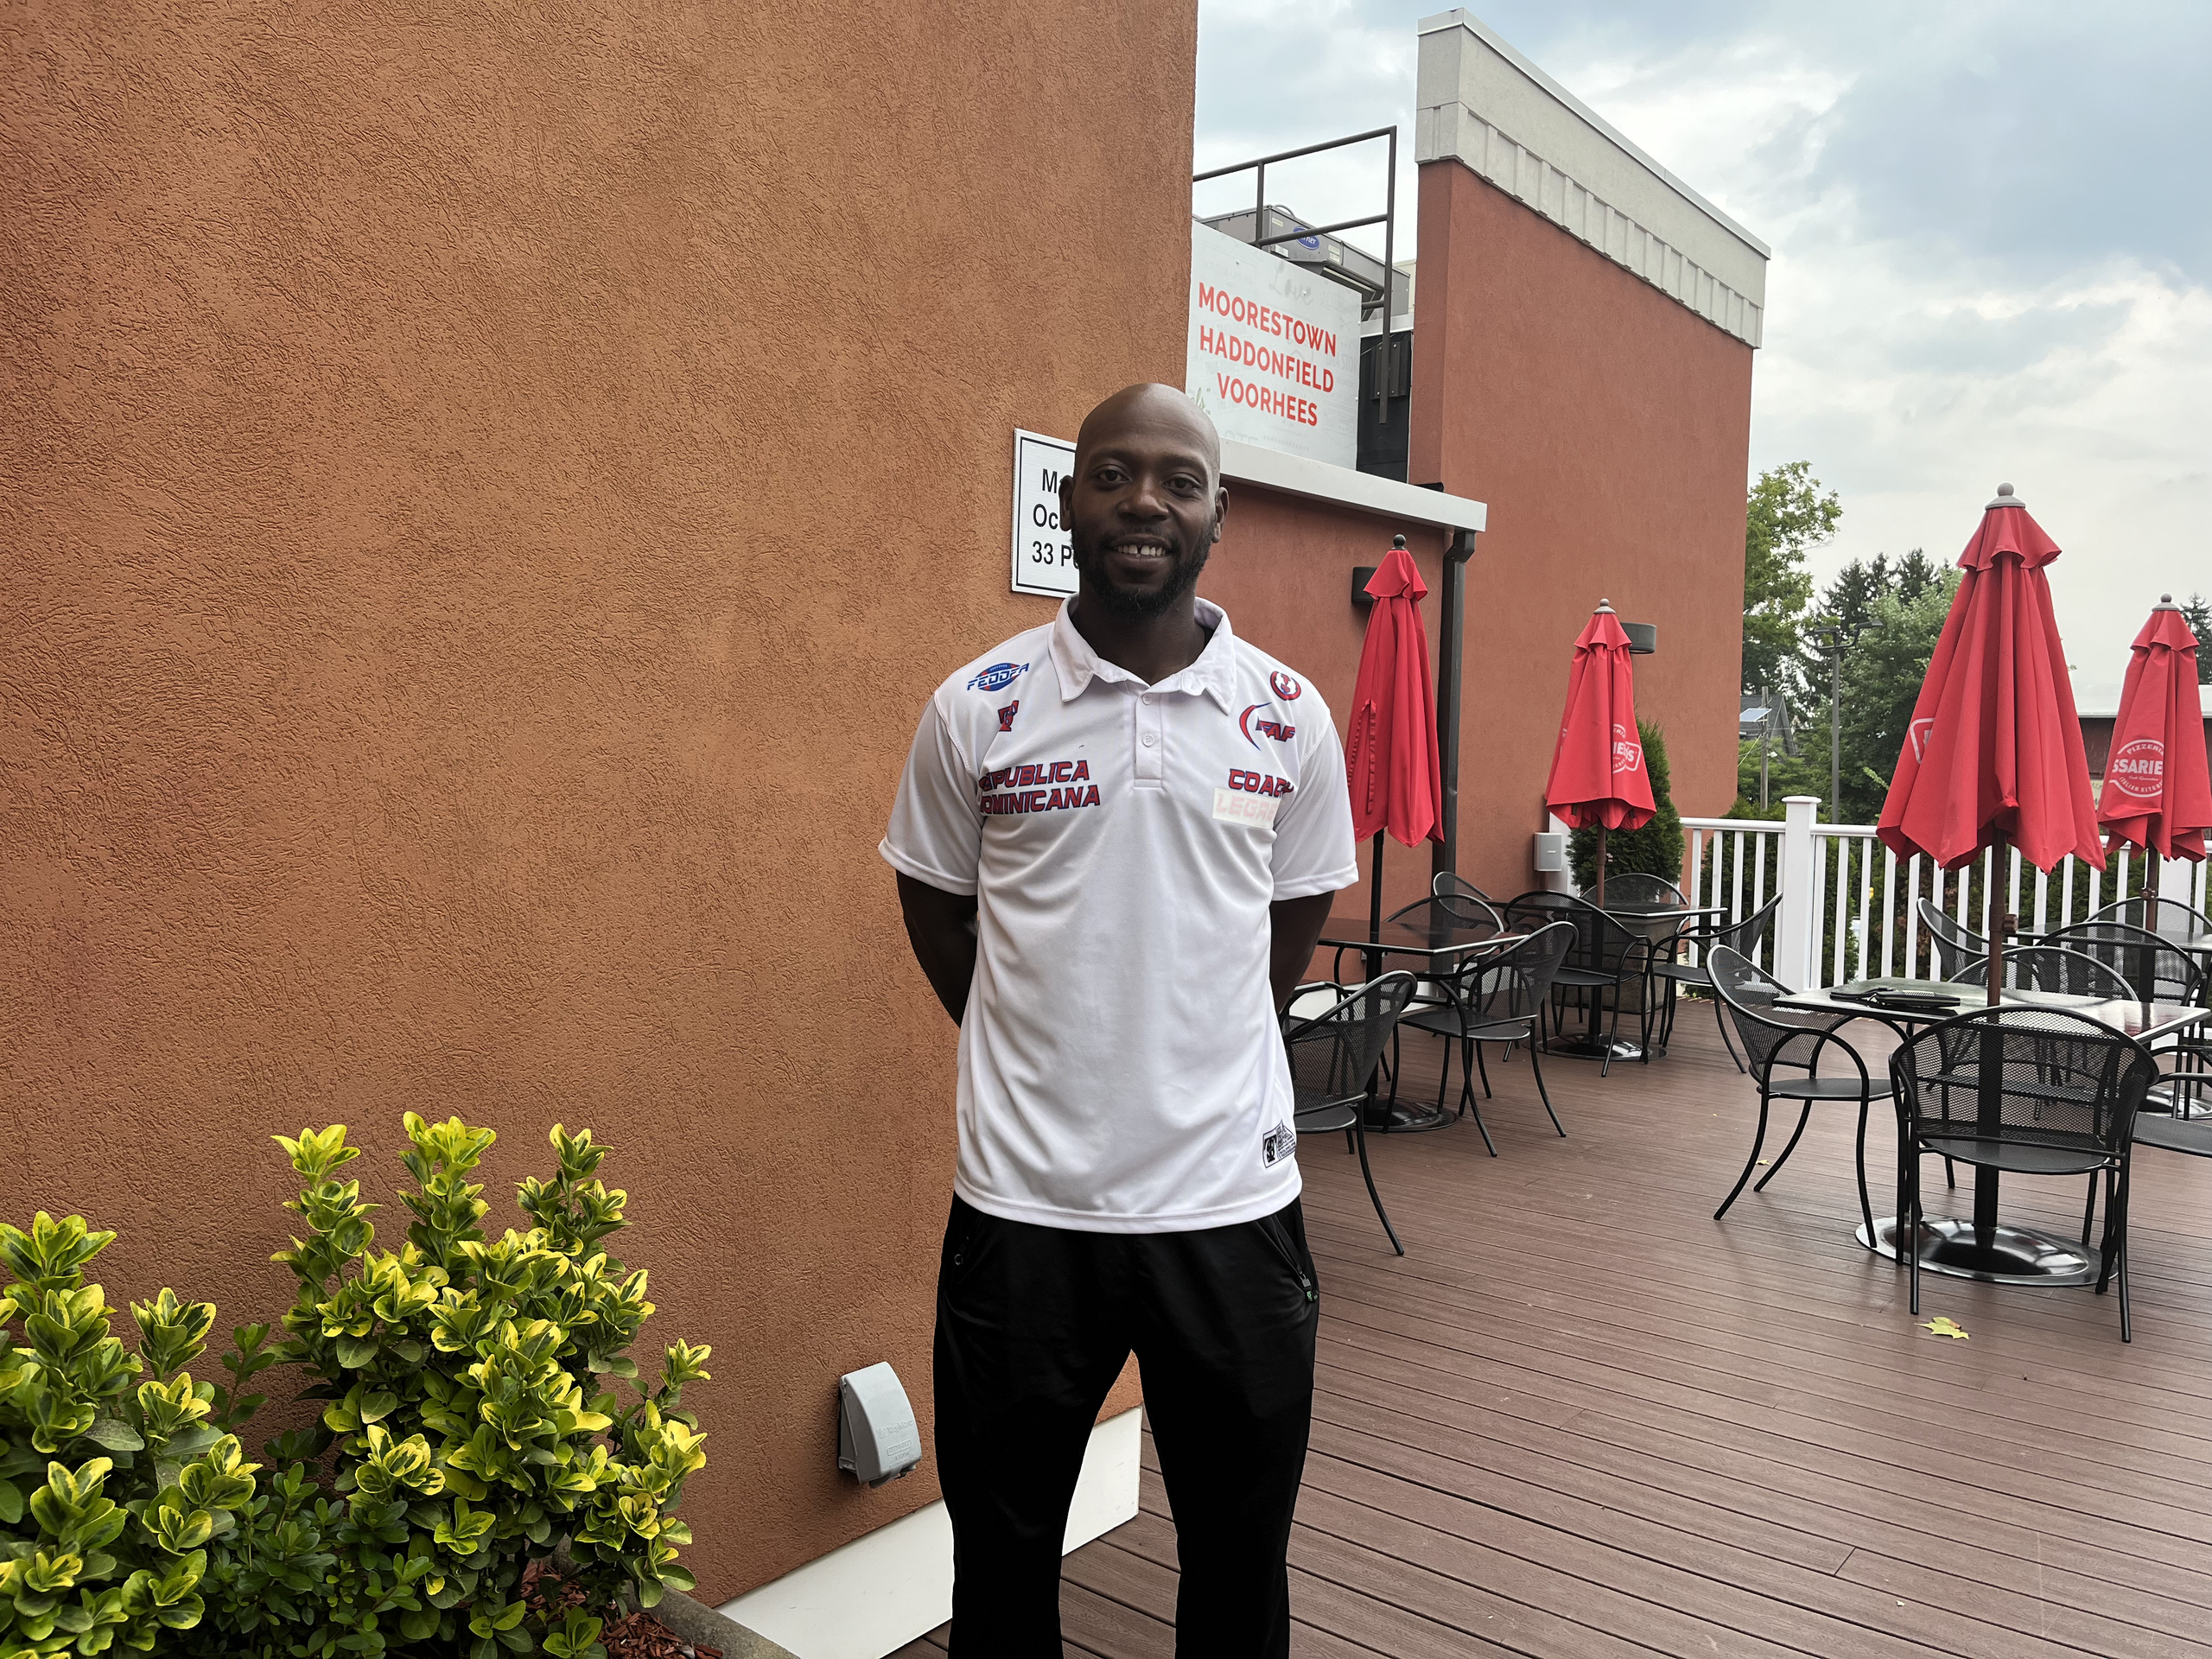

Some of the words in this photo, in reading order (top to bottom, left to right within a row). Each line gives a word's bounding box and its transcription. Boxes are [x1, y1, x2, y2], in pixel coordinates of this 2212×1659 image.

[1198, 282, 1337, 357] MOORESTOWN
[1199, 325, 1334, 393] HADDONFIELD
[1217, 372, 1319, 426] VOORHEES
[1032, 540, 1054, 565] 33
[978, 760, 1090, 792] PUBLICA
